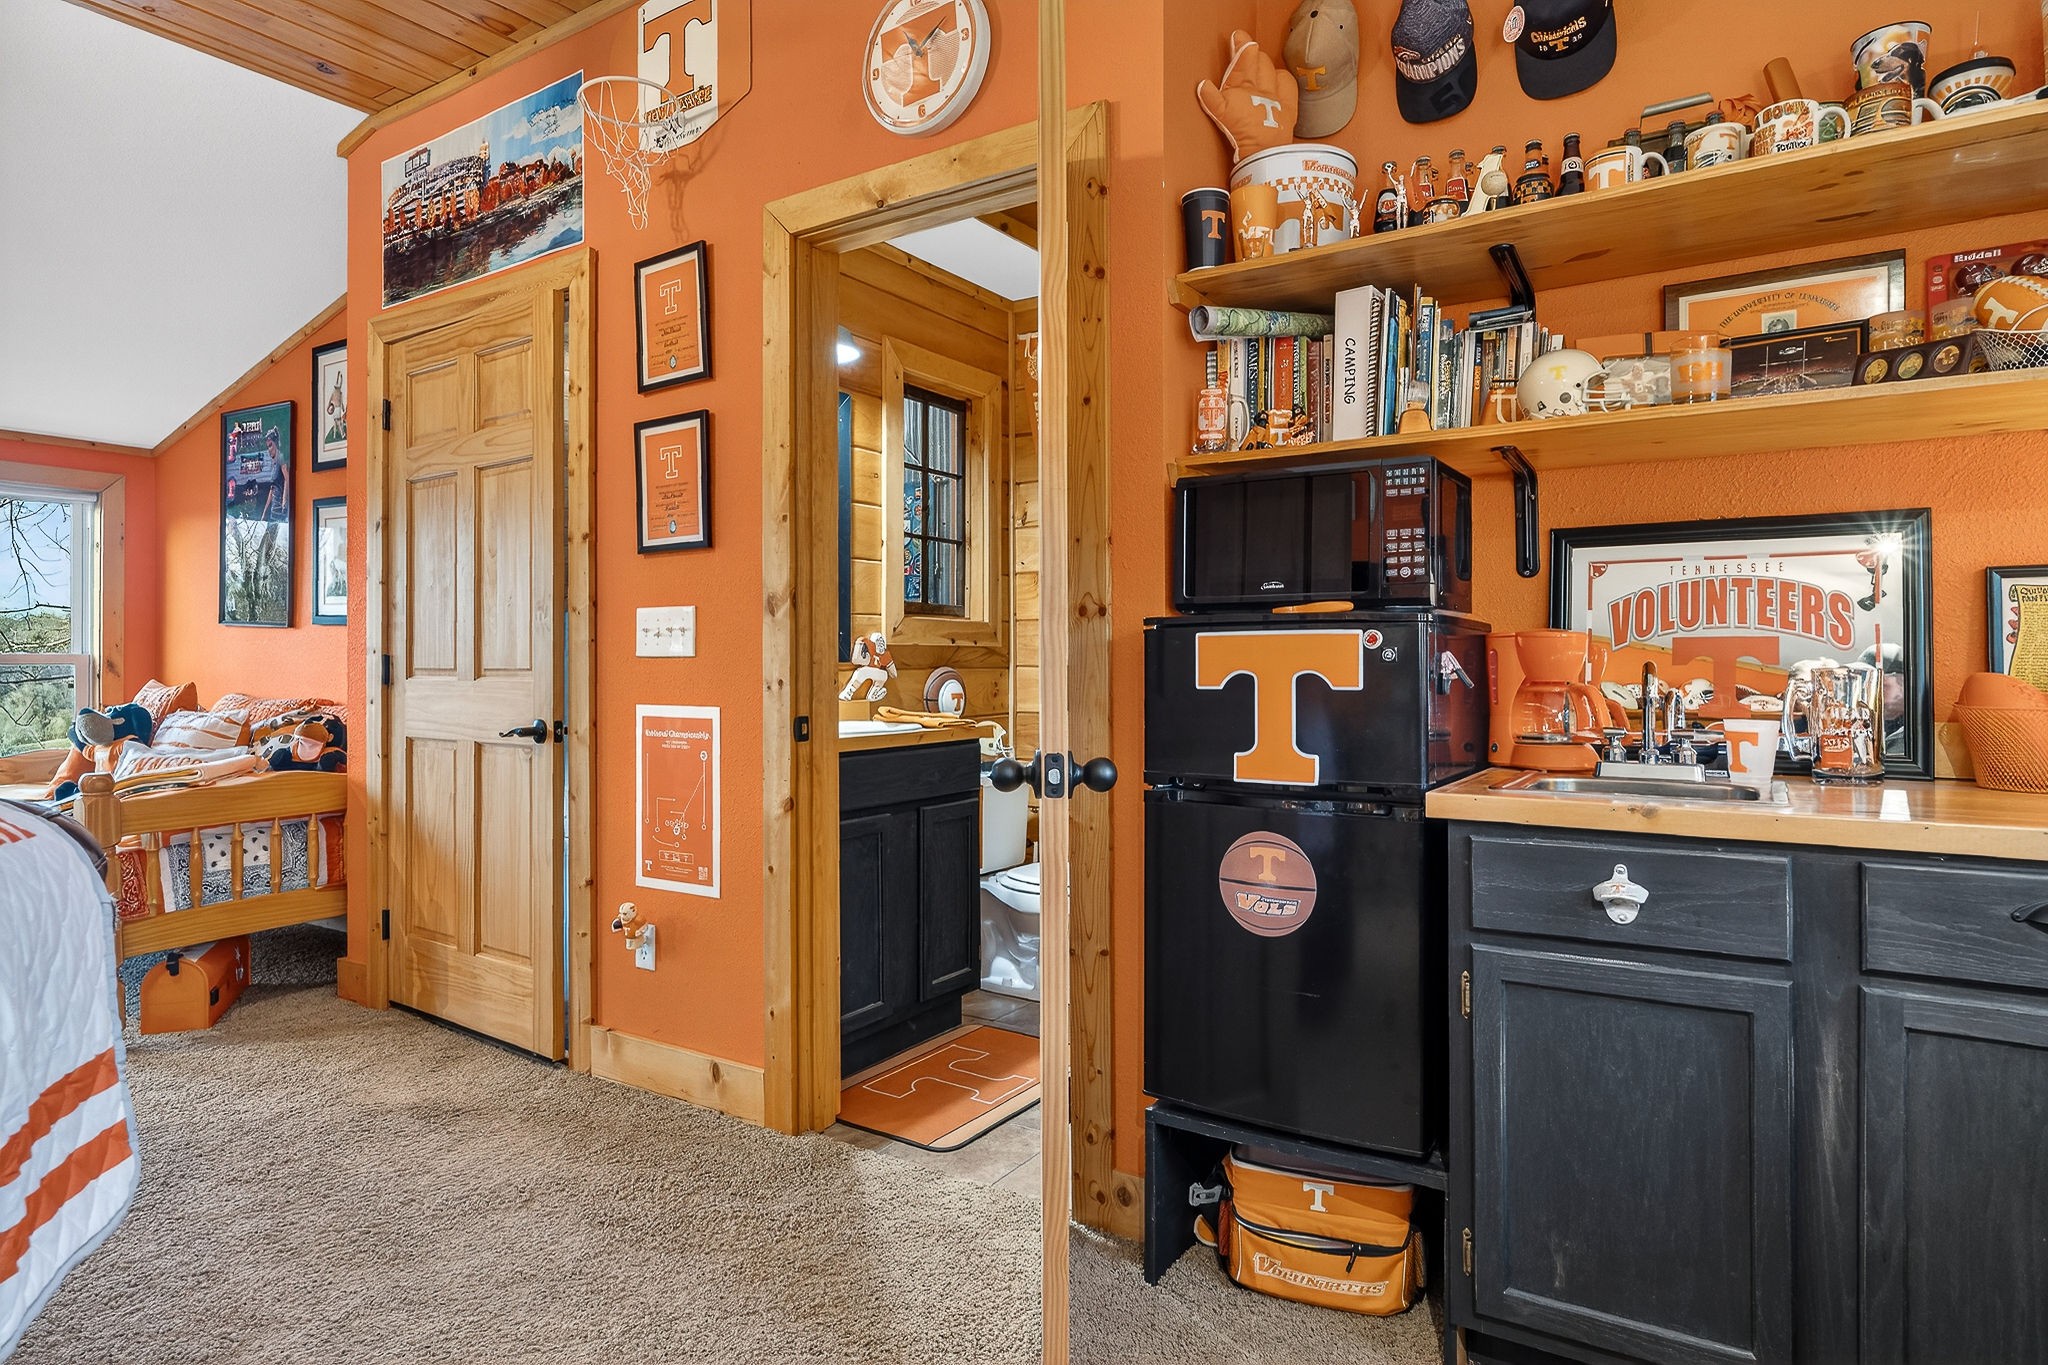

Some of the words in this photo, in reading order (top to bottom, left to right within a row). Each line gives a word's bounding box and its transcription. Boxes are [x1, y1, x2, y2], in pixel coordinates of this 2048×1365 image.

[960, 27, 970, 41] 3
[880, 0, 958, 108] T
[1296, 65, 1326, 91] T
[1251, 95, 1282, 128] T
[1201, 209, 1226, 239] T
[1953, 248, 2002, 263] Riddell
[659, 278, 682, 316] T
[1983, 296, 2019, 329] T
[1343, 337, 1356, 405] CAMPING
[1548, 365, 1568, 380] T
[660, 445, 683, 480] T
[1669, 561, 1785, 577] TENNESSEE
[1608, 575, 1855, 651] VOLUNTEERS
[1672, 636, 1780, 719] T
[951, 693, 963, 712] T
[1195, 629, 1363, 786] T
[1725, 731, 1759, 773] T
[1249, 846, 1286, 882] T
[1302, 1181, 1335, 1213] T
